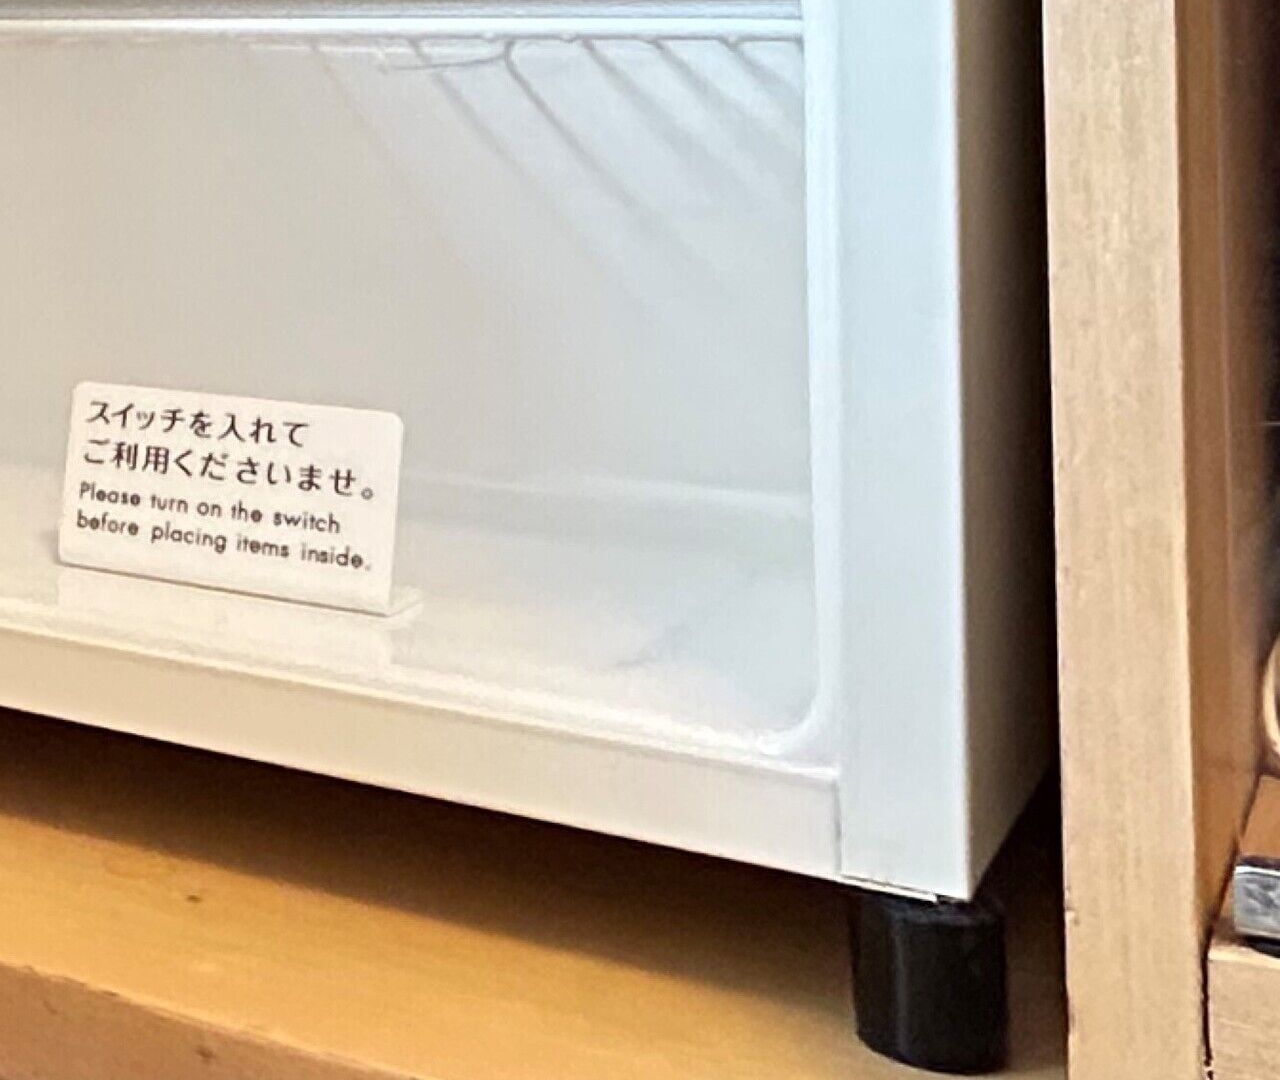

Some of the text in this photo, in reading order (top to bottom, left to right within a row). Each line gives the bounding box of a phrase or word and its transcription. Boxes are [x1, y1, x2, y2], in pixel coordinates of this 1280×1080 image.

[86, 400, 310, 448] スイッチを入れて
[83, 437, 375, 500] ご利用くださいませ。
[78, 480, 341, 535] Please turn on the switch
[76, 509, 372, 572] before placing items inside.
